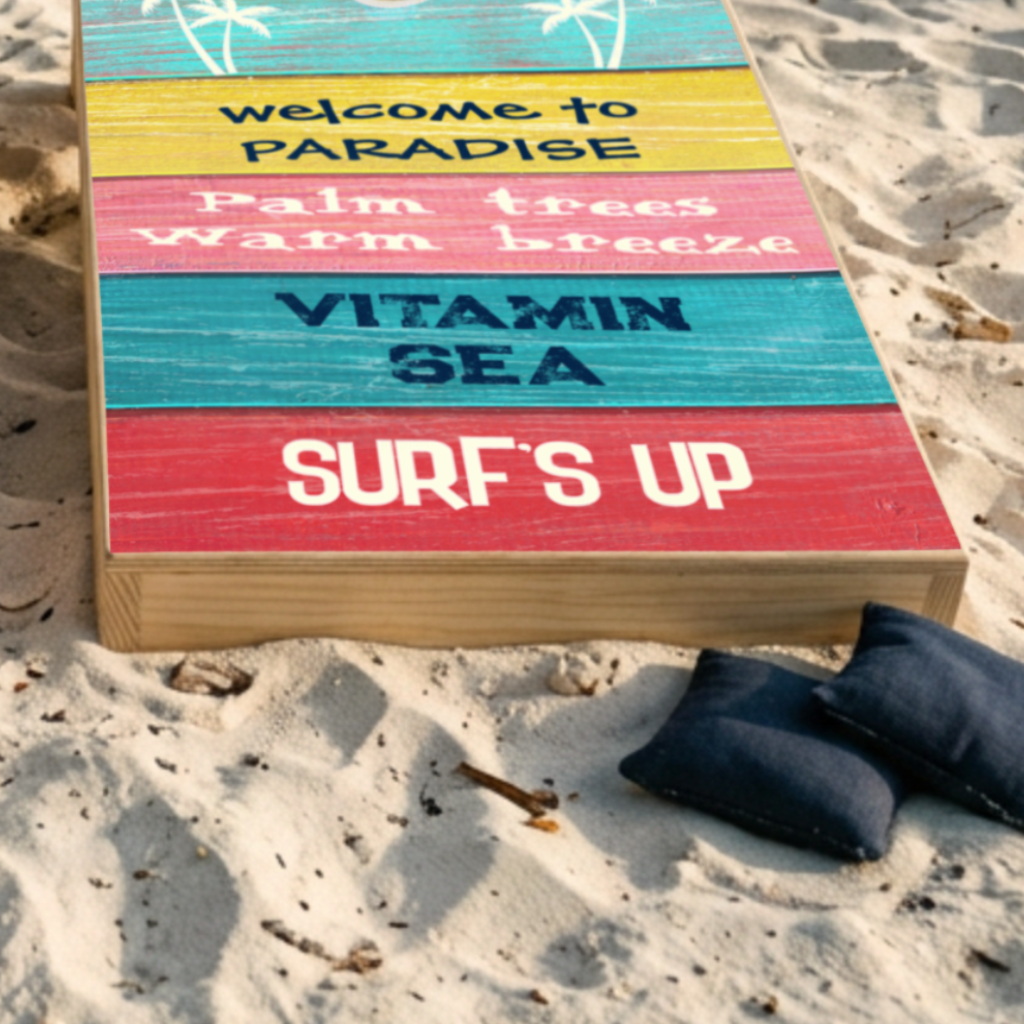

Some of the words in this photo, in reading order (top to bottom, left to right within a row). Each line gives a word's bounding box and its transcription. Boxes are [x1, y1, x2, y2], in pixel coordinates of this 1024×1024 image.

[218, 98, 543, 125] welcome
[560, 97, 639, 125] to
[240, 137, 642, 162] PARADISE
[484, 188, 719, 217] trees
[490, 224, 801, 255] breeze
[274, 292, 692, 332] VITAMIN
[388, 344, 606, 387] SEA
[281, 435, 602, 511] SURF'S
[632, 442, 754, 511] UP
